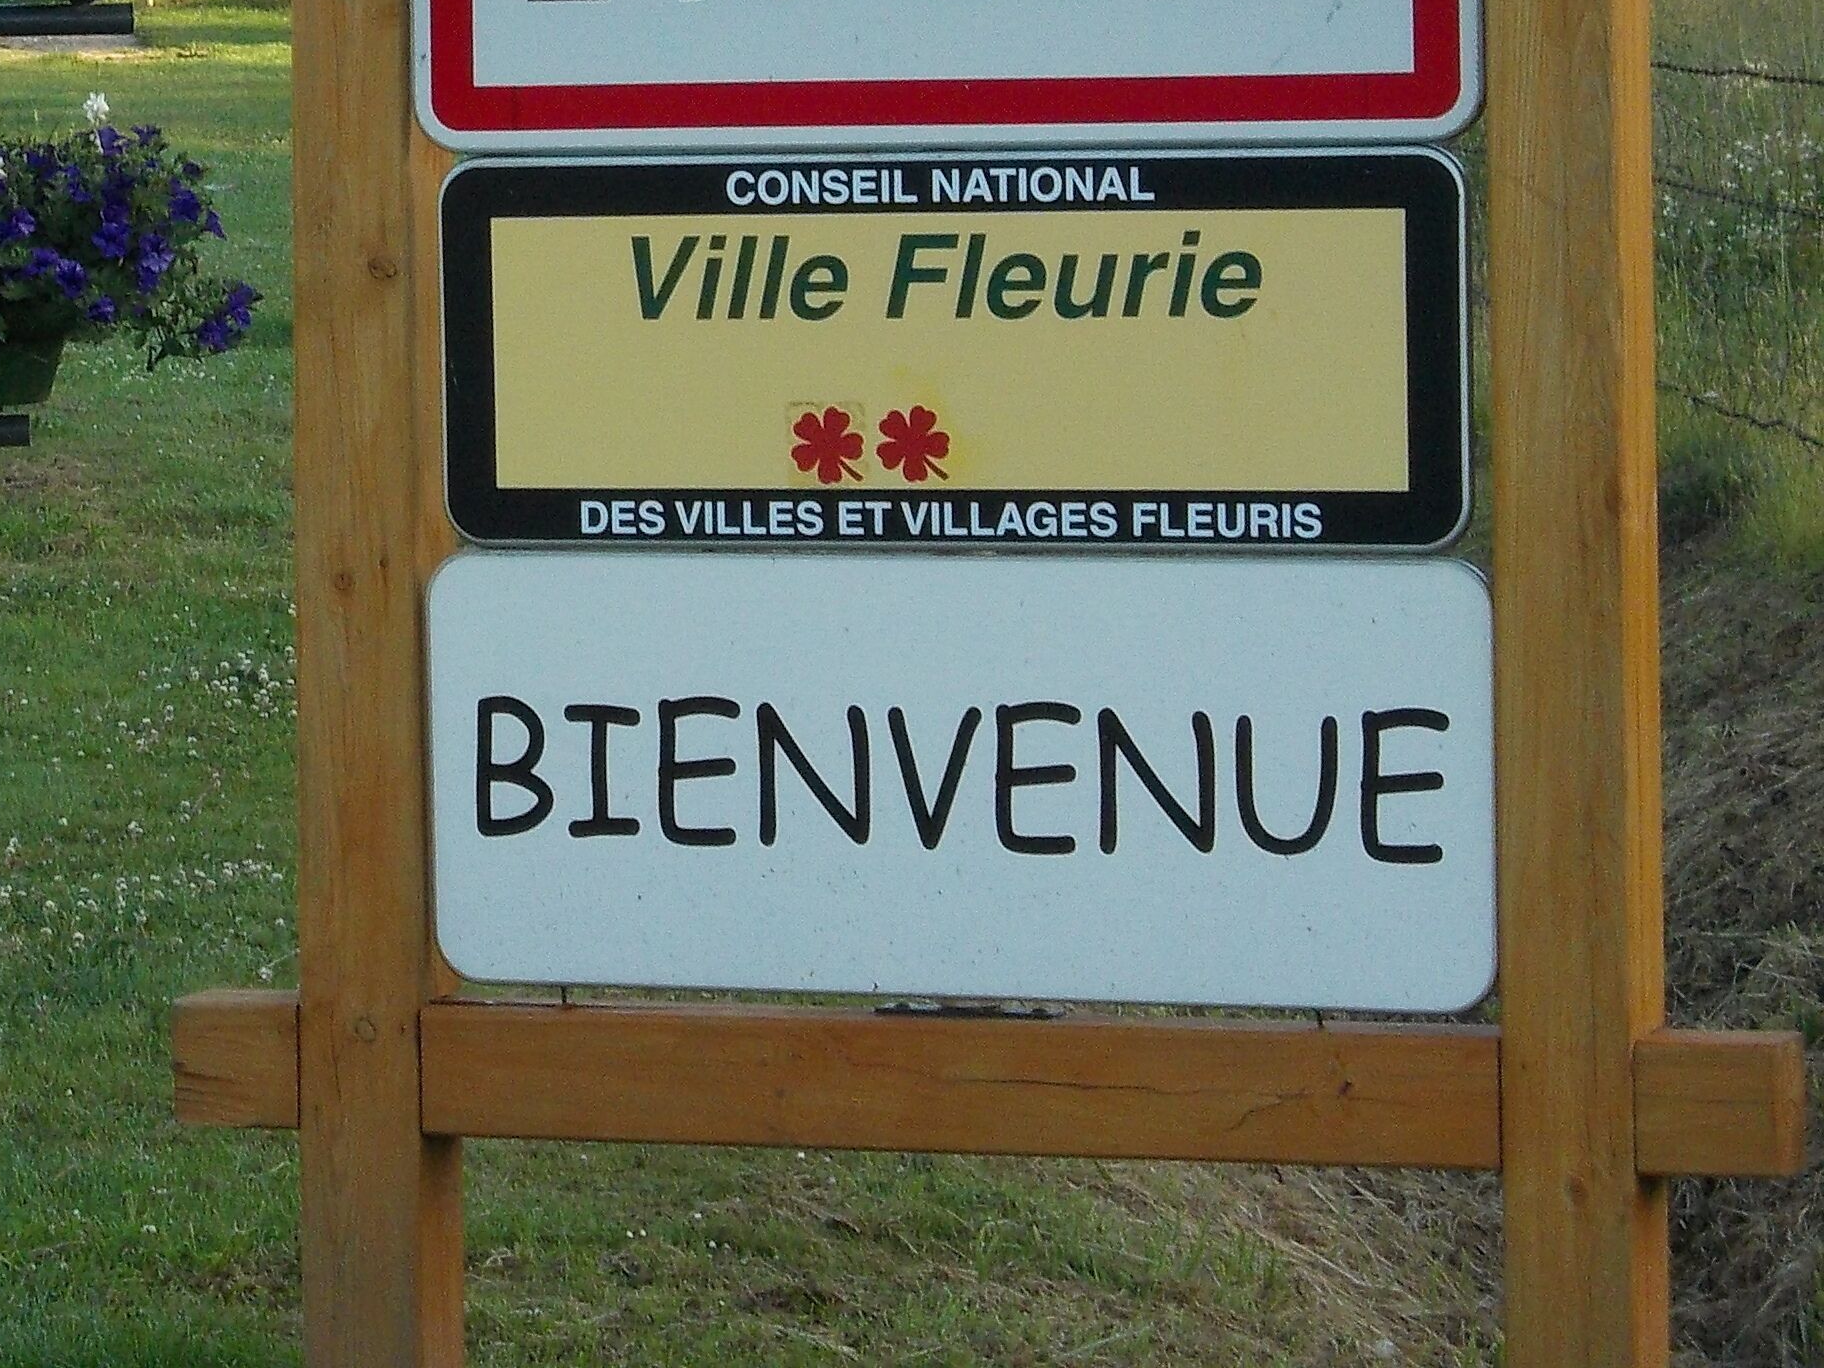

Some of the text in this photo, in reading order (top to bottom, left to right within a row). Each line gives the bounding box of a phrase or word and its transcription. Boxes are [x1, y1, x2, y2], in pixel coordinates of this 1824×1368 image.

[725, 166, 1156, 206] CONSEIL NATIONAL
[629, 230, 1264, 322] Ville Fleurie
[580, 500, 1324, 540] DES VILLES ET VILLAGES FLEURIS
[474, 694, 1451, 864] BIENVENUE
